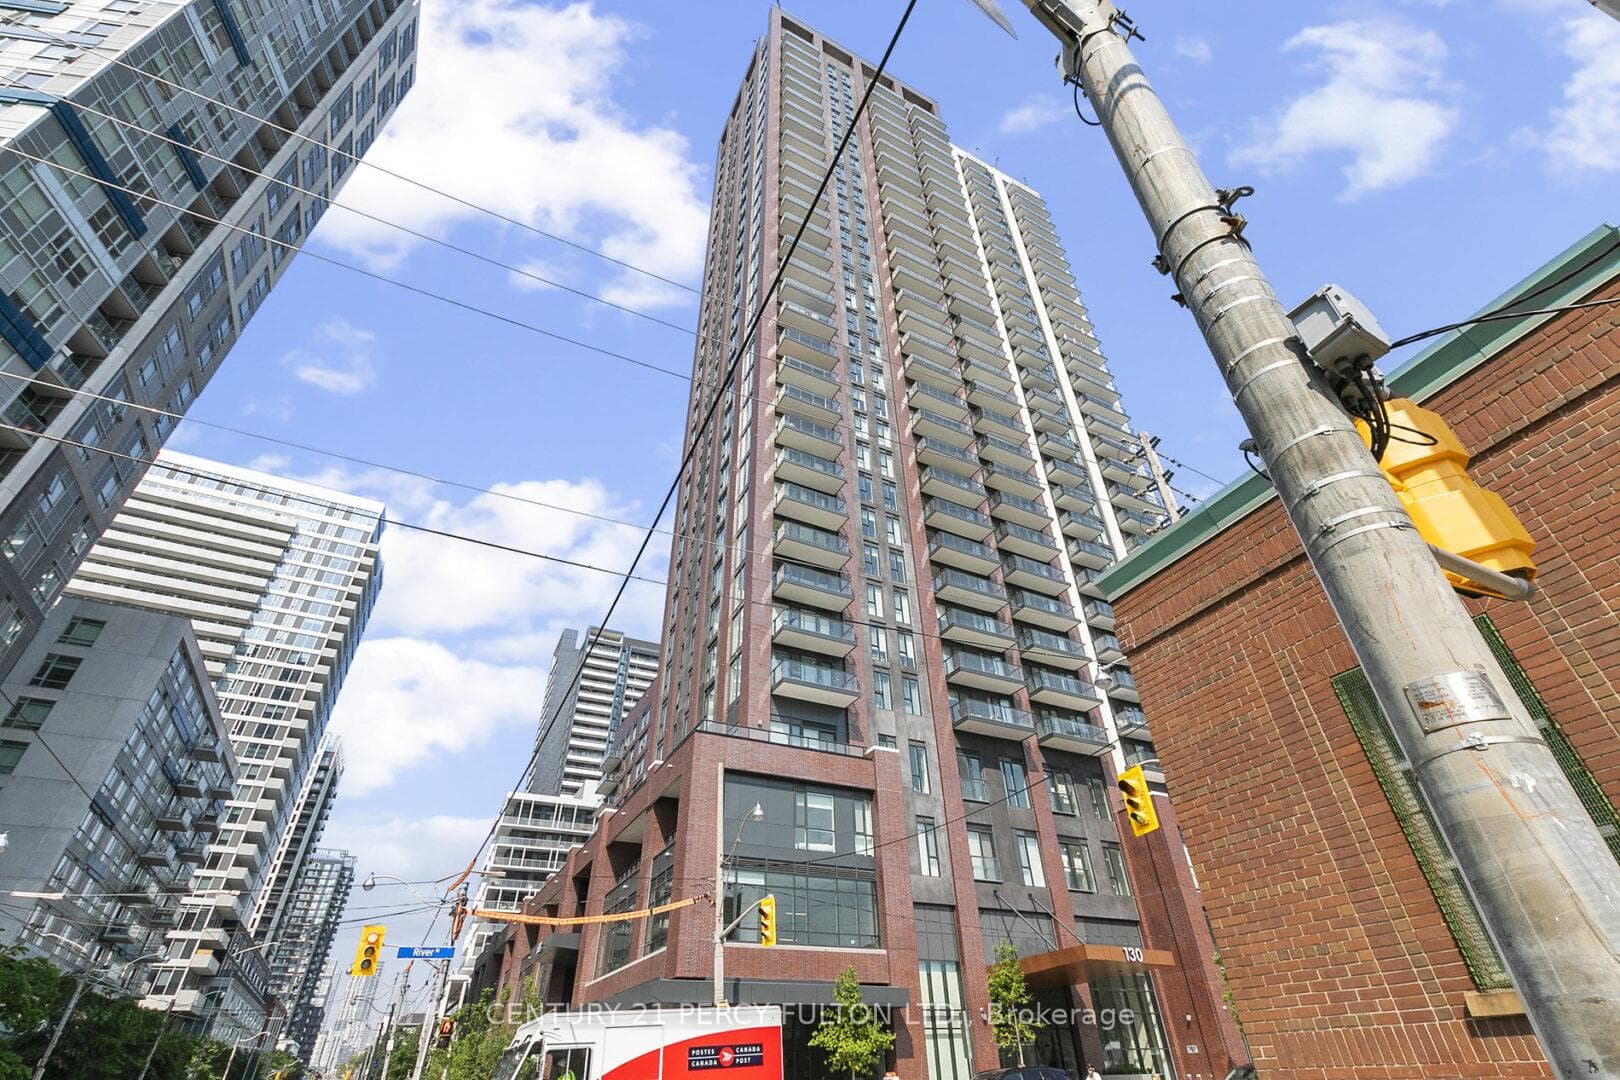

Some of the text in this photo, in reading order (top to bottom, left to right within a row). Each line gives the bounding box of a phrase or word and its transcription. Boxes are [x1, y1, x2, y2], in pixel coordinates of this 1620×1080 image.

[412, 947, 435, 957] River
[1122, 946, 1144, 962] 130
[691, 1048, 715, 1056] POSTES
